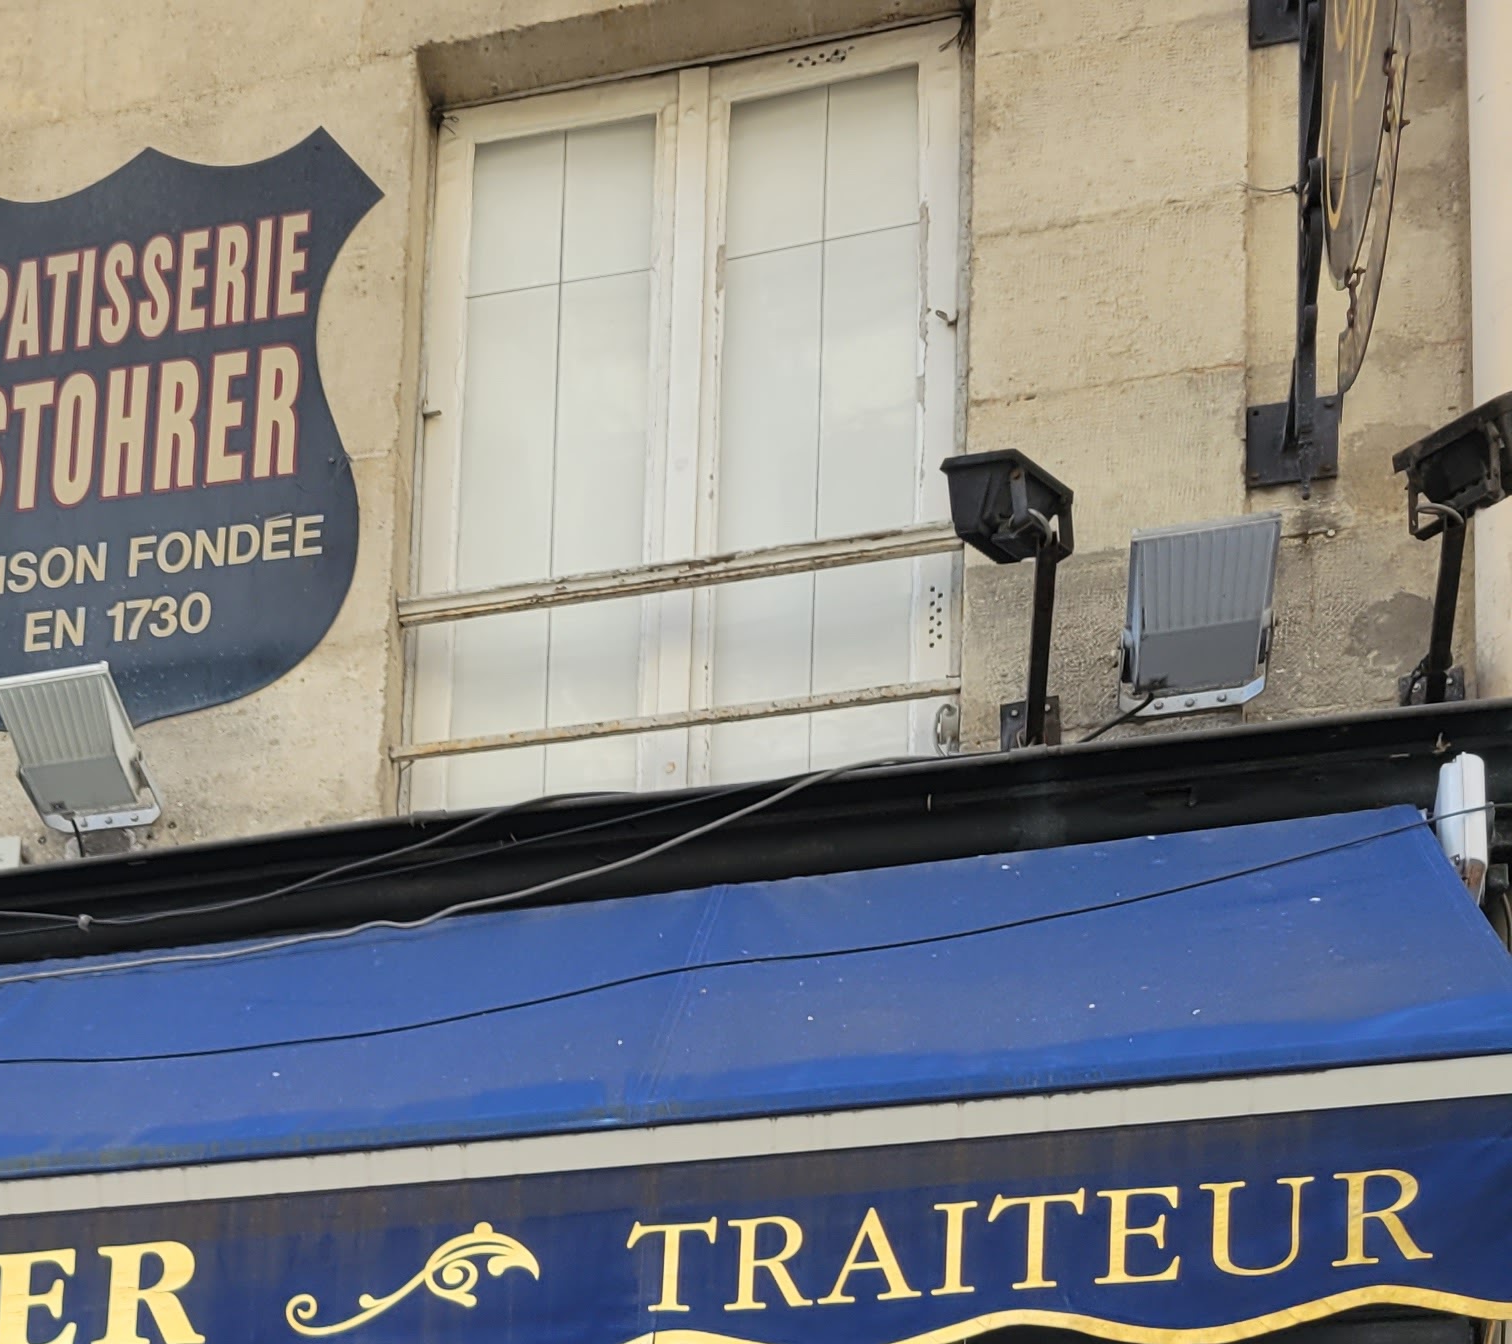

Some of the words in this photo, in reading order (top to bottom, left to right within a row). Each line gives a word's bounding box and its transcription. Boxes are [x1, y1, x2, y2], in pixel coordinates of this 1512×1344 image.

[128, 512, 324, 577] FONDÉE
[23, 606, 86, 653] EN
[106, 591, 213, 643] 1730
[626, 1167, 1433, 1313] TRAITEUR
